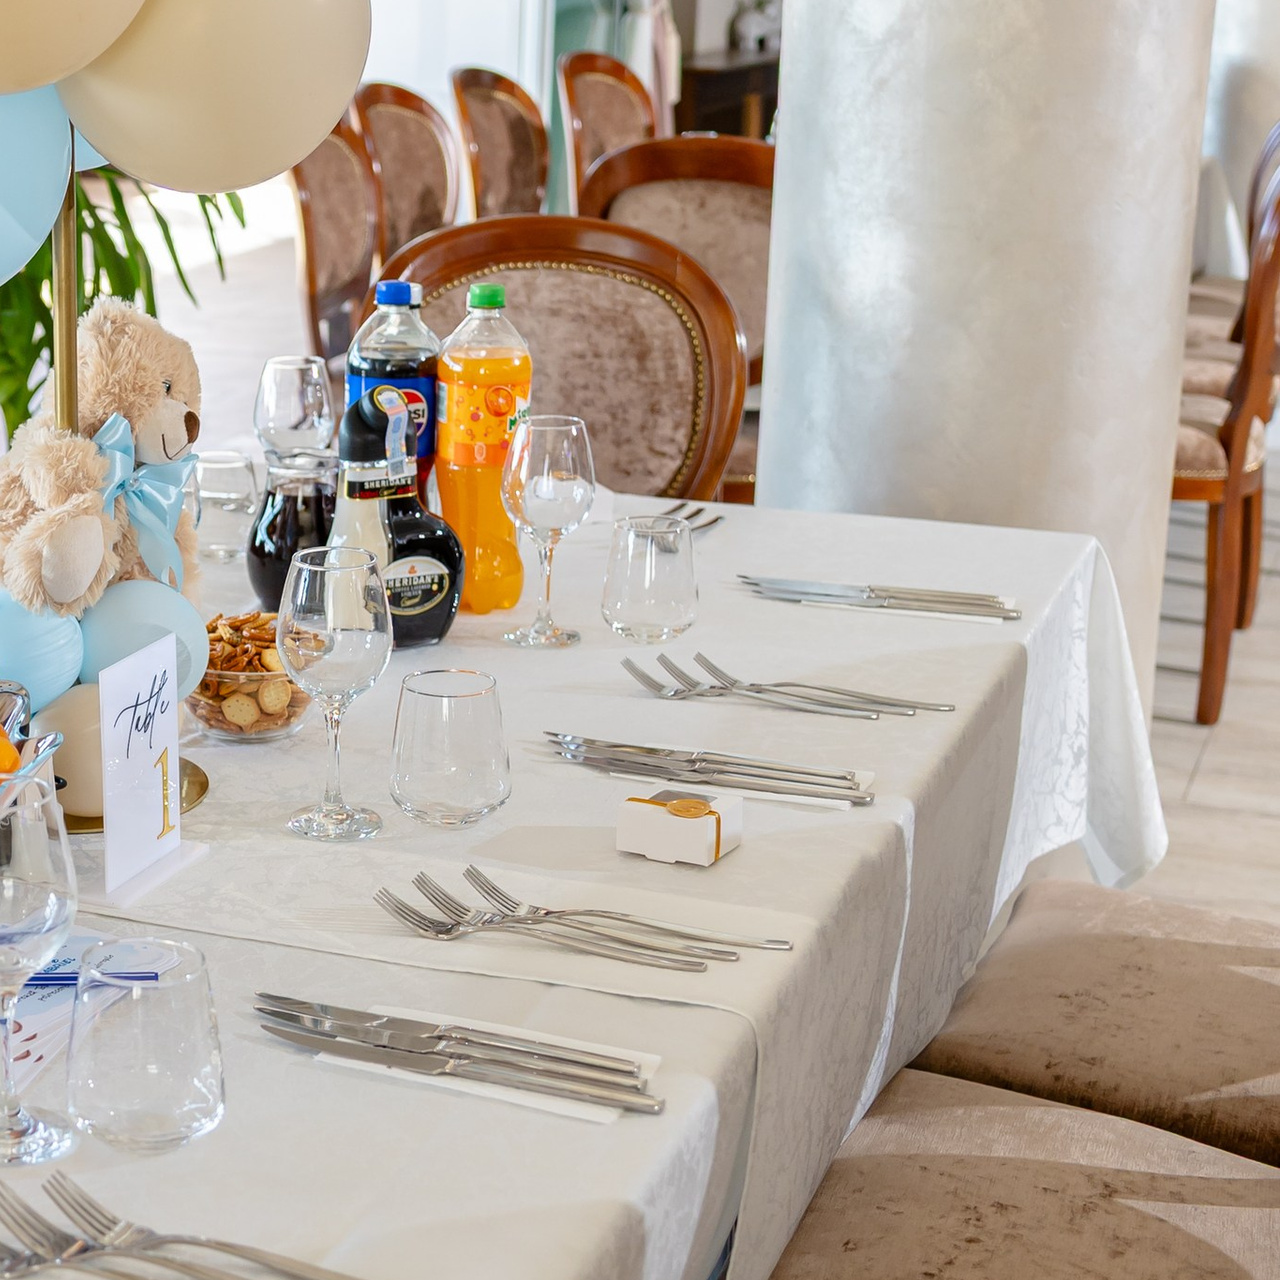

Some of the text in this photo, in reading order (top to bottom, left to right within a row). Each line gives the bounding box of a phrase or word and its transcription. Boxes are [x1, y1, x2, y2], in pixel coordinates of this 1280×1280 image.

[387, 573, 439, 588] HERIDAN'S
[113, 669, 170, 759] Table
[153, 746, 176, 840] 1
